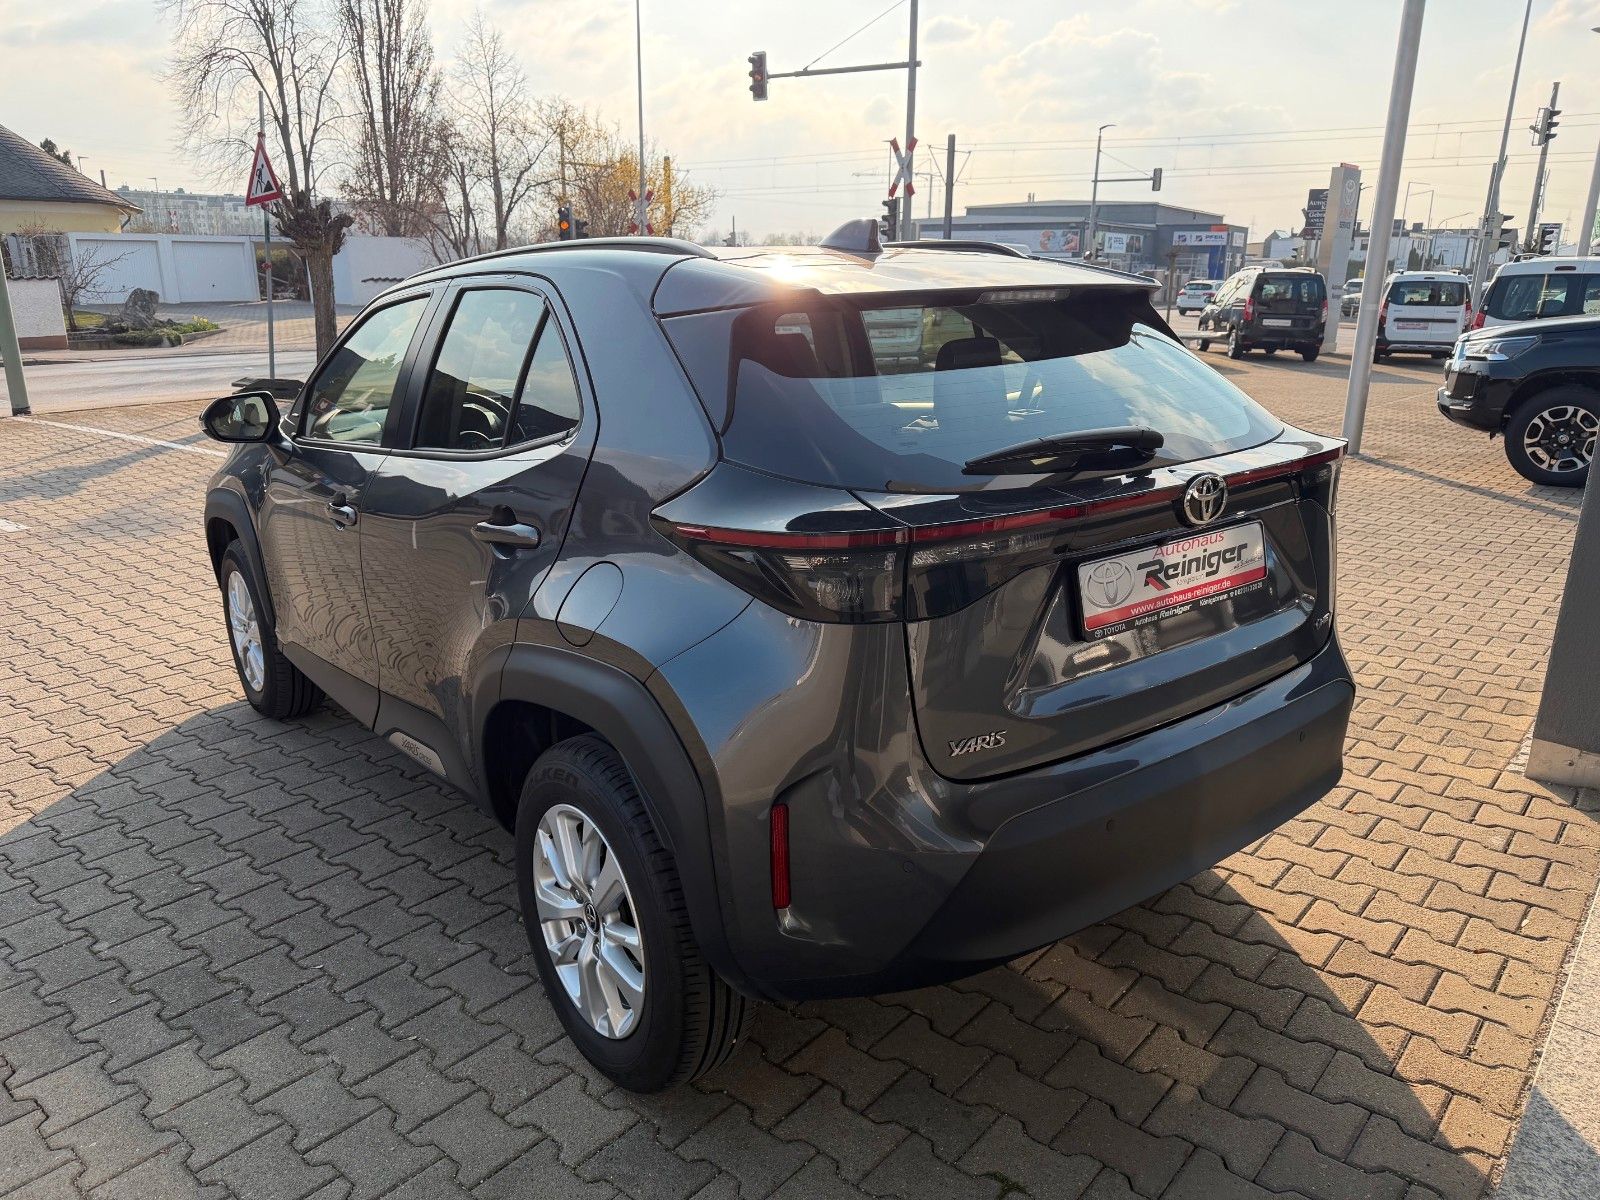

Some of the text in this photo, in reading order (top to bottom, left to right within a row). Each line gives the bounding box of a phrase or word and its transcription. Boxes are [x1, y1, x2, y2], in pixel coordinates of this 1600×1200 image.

[1152, 531, 1225, 560] Autohaus
[1137, 543, 1248, 591] Reiniger
[1103, 624, 1126, 636] TOYOTA
[1134, 614, 1158, 626] Autohaus
[1159, 604, 1193, 619] Reiniger
[1199, 592, 1229, 607] Königsbrunn
[1130, 579, 1231, 616] www.autohaus-reiniger.de
[401, 739, 420, 756] YARIS
[949, 730, 1008, 757] YARIS
